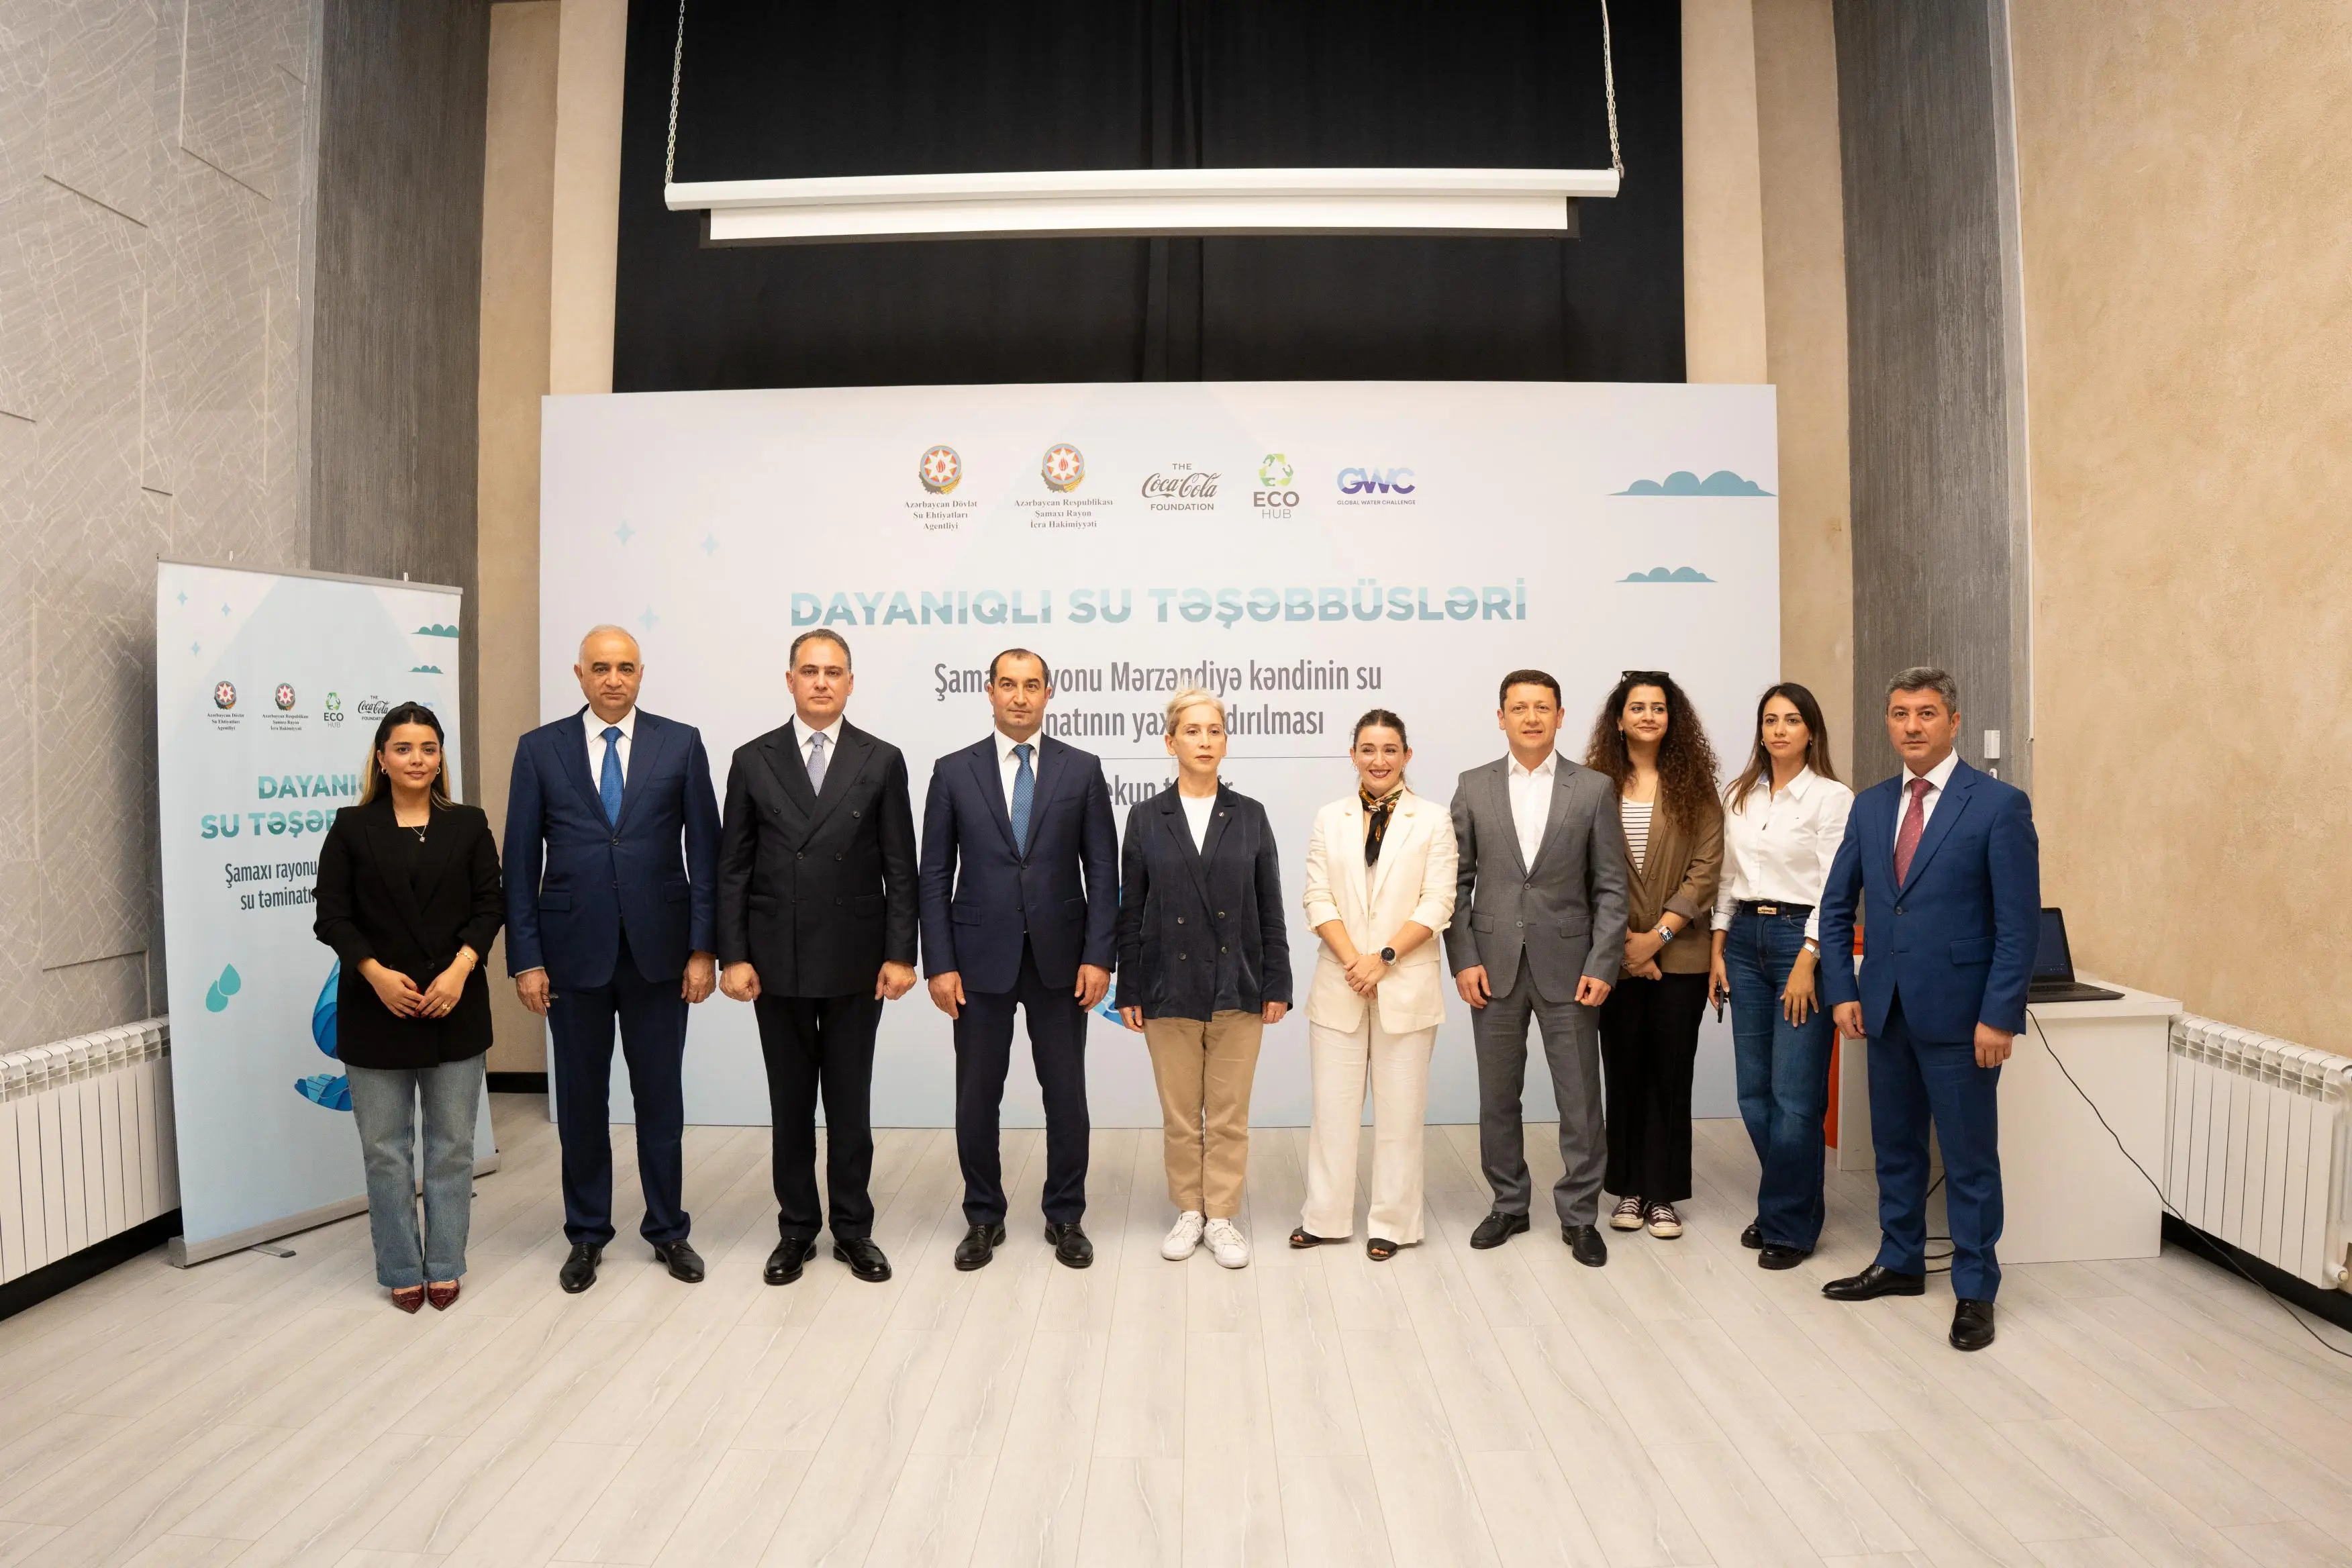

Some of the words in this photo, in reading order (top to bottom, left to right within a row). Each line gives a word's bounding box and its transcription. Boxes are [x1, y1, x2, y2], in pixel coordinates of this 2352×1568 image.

[1337, 467, 1416, 495] GWC
[1014, 499, 1061, 508] Azərbaycan
[1063, 498, 1114, 507] Respublikası
[1253, 491, 1300, 507] ECO
[904, 501, 950, 509] Azərbaycan
[952, 500, 977, 508] Dövlət
[1150, 503, 1214, 511] FOUNDATION
[926, 511, 968, 520] Ehtiyatları
[1067, 509, 1091, 518] Rayon
[1262, 509, 1291, 519] HUB
[924, 522, 959, 531] Agentliyi
[1030, 520, 1046, 528] İcra
[1048, 520, 1097, 529] Hakimiyyəti
[791, 589, 1052, 627] DAYANIQLI
[1067, 588, 1132, 624] SU
[1147, 577, 1526, 630] TƏŞƏBBÜSLƏRİ
[1048, 667, 1101, 699] yonu
[1111, 660, 1242, 698] Mərzəndiyə
[1250, 660, 1349, 690] kəndinin
[1356, 666, 1381, 690] su
[324, 713, 344, 722] ECO
[258, 774, 363, 799] DAYANI
[201, 814, 240, 839] SU
[225, 863, 272, 889] Şamaxı
[276, 861, 317, 882] rayonu
[240, 894, 254, 910] su
